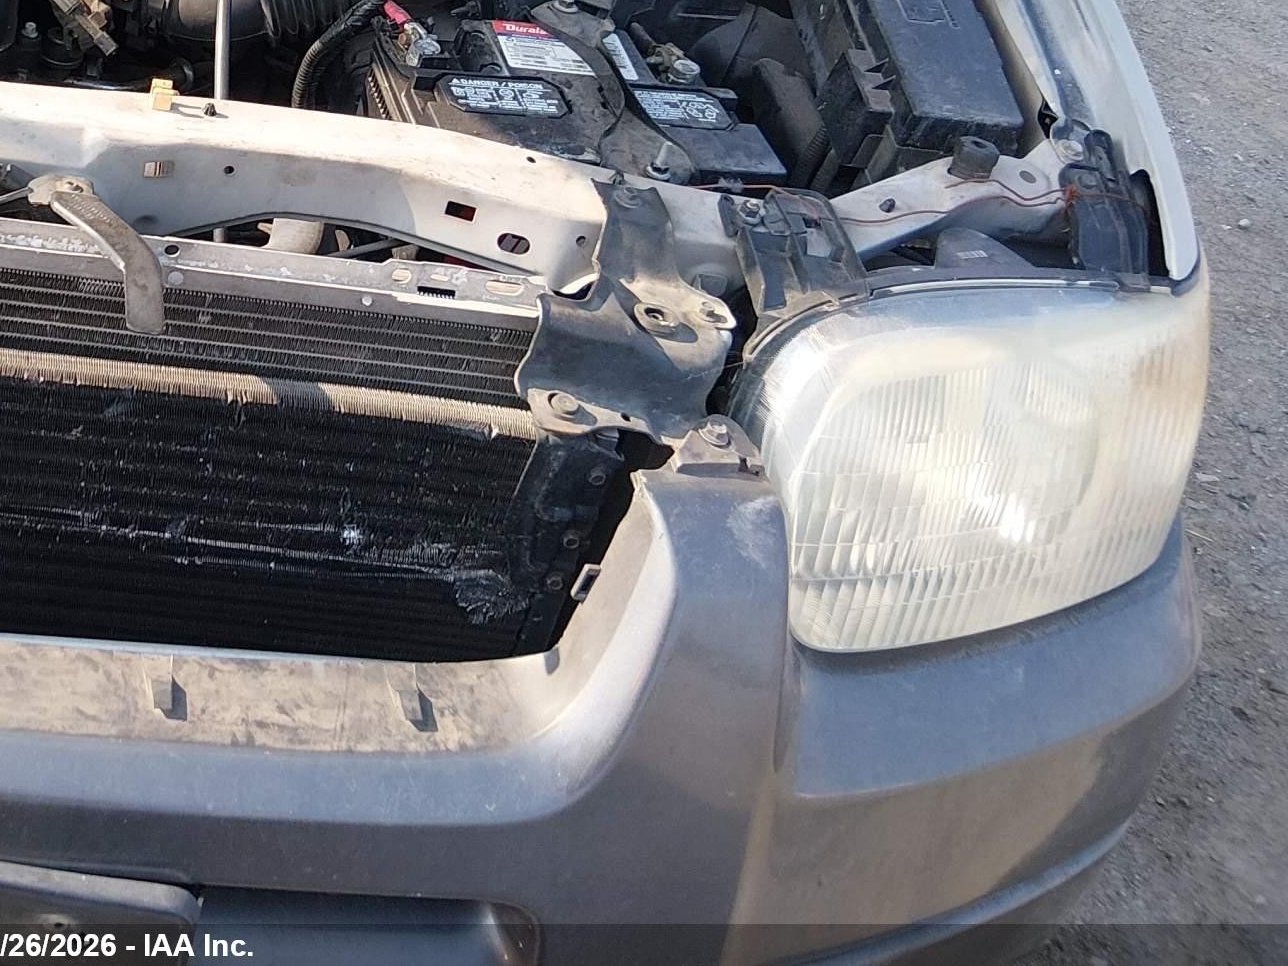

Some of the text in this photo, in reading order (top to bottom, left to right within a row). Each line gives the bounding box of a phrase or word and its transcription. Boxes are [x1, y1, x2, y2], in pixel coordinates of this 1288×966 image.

[502, 23, 548, 34] Durala
[460, 78, 499, 87] DANGER
[507, 81, 544, 90] POISON
